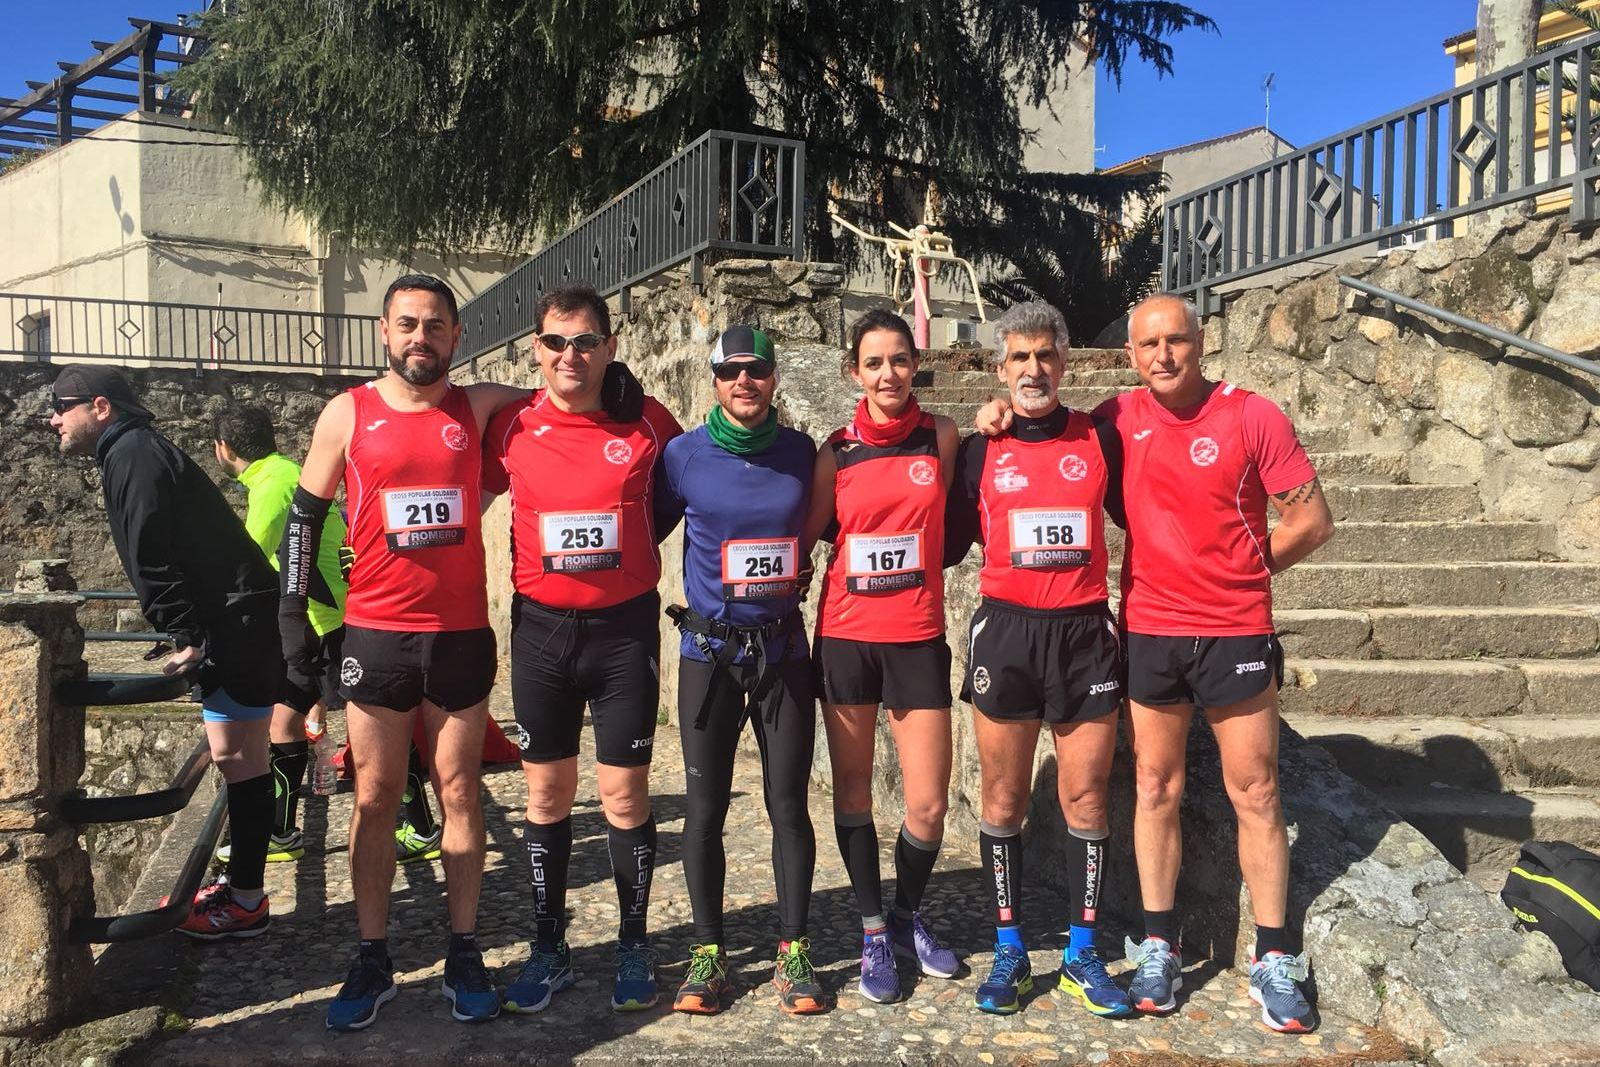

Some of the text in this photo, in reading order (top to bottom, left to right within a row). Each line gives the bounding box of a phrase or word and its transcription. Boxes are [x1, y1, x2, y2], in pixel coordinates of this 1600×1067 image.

[406, 502, 450, 525] 219
[301, 524, 312, 552] MEDIO
[411, 529, 457, 541] ROMERO
[560, 527, 604, 549] 253
[891, 535, 915, 544] SOLIDARIO
[1033, 525, 1074, 545] 158
[287, 523, 300, 594] DE NAVALMORAL
[565, 554, 613, 565] ROMERO
[867, 549, 906, 571] 167
[1035, 551, 1082, 560] ROMERO
[298, 554, 311, 596] MARATON
[745, 556, 783, 577] 254
[748, 582, 790, 593] ROMERO
[870, 573, 916, 586] ROMERO
[528, 842, 548, 915] kalenji
[630, 844, 650, 915] kalenji
